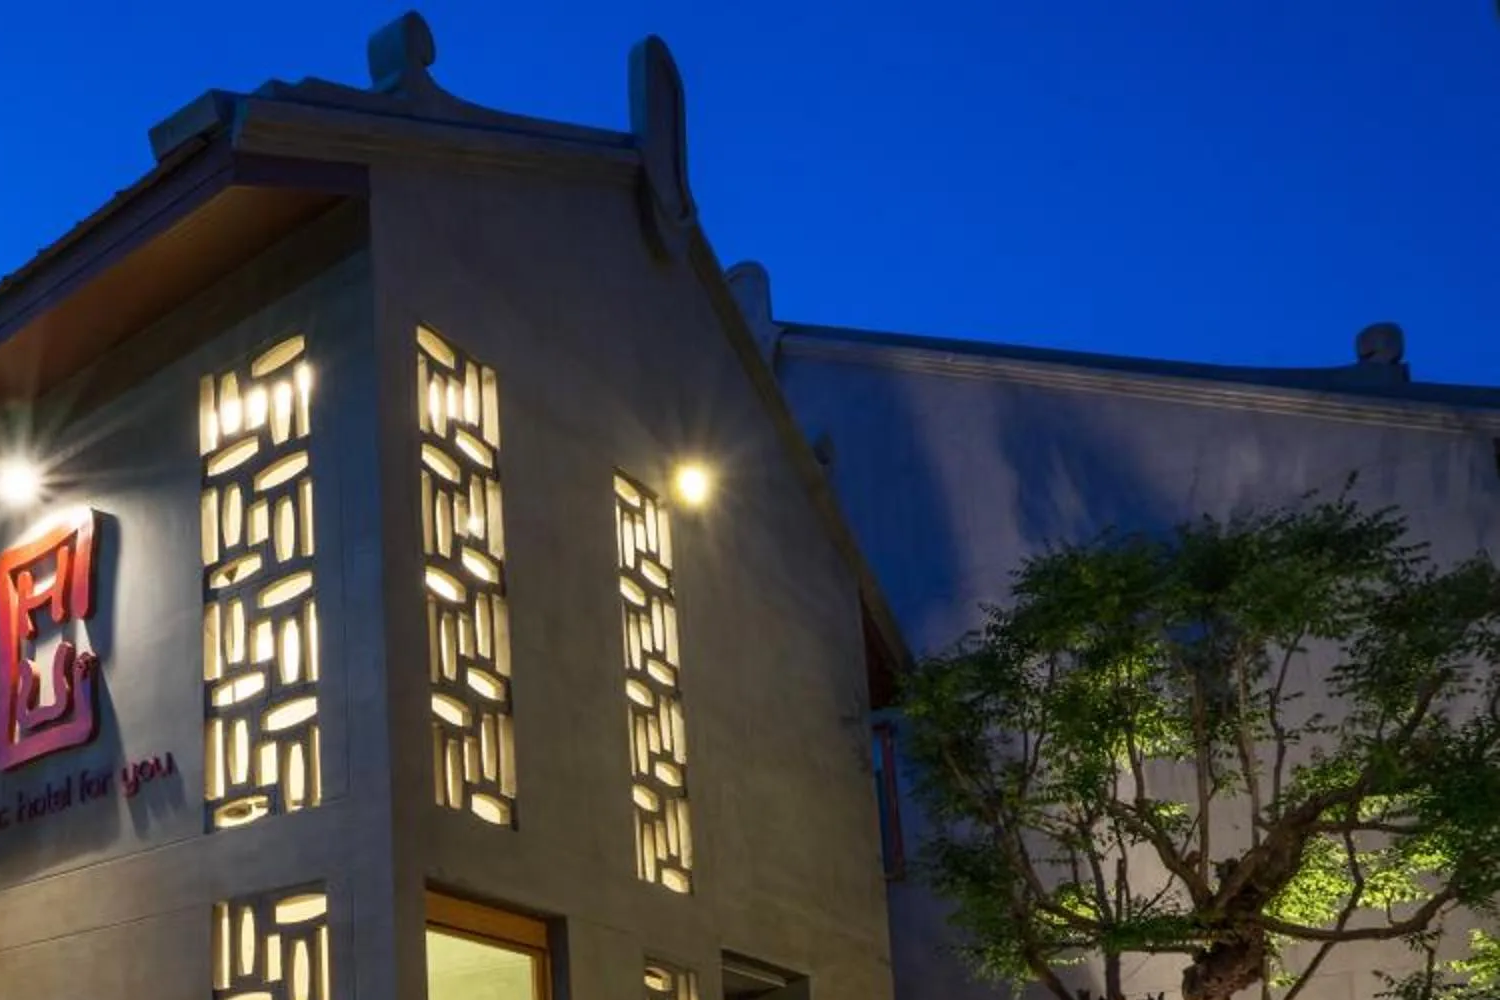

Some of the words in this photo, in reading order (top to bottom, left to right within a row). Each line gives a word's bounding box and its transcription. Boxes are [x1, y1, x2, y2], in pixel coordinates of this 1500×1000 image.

[16, 774, 72, 823] hotel
[80, 767, 114, 804] for
[122, 752, 176, 799] you
